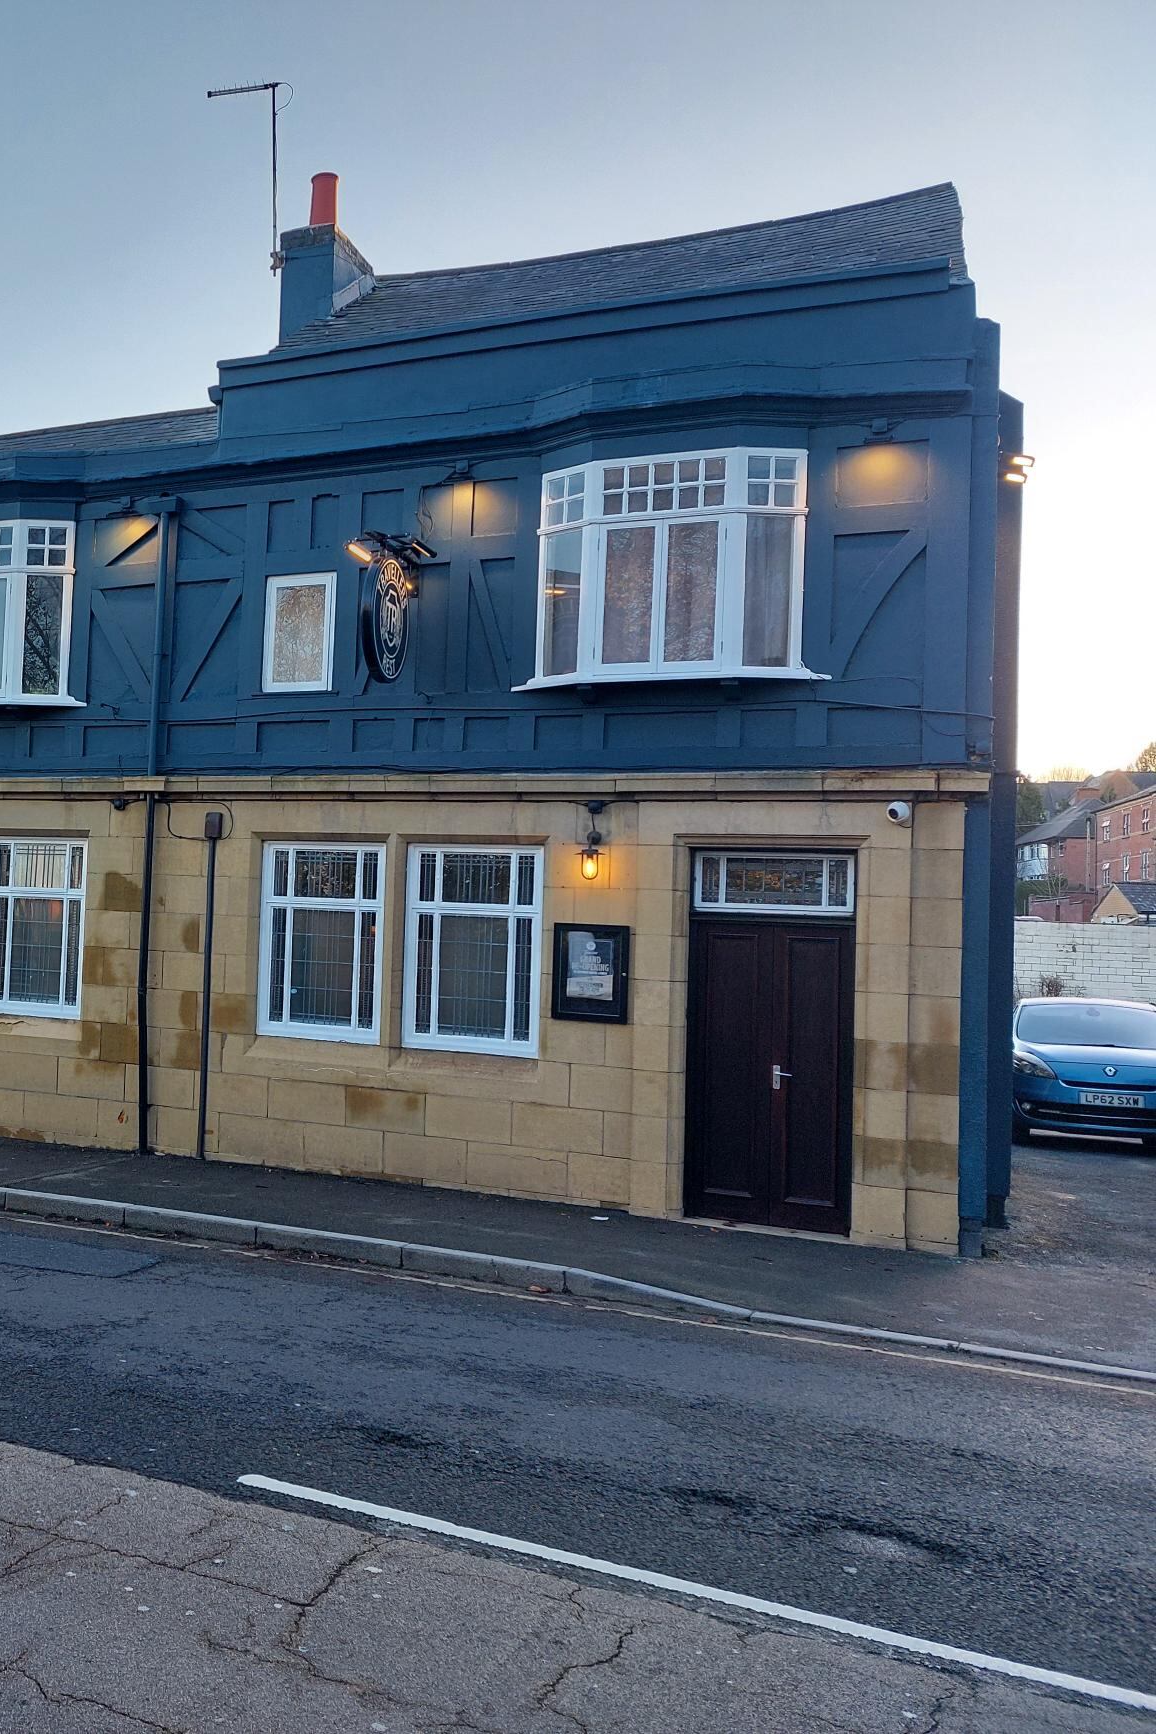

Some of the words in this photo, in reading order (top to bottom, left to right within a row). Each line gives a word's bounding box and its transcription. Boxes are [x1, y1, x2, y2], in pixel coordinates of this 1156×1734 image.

[377, 563, 409, 610] TRAVELLERS
[1085, 1094, 1115, 1105] LP62
[1117, 1095, 1140, 1107] SXW
